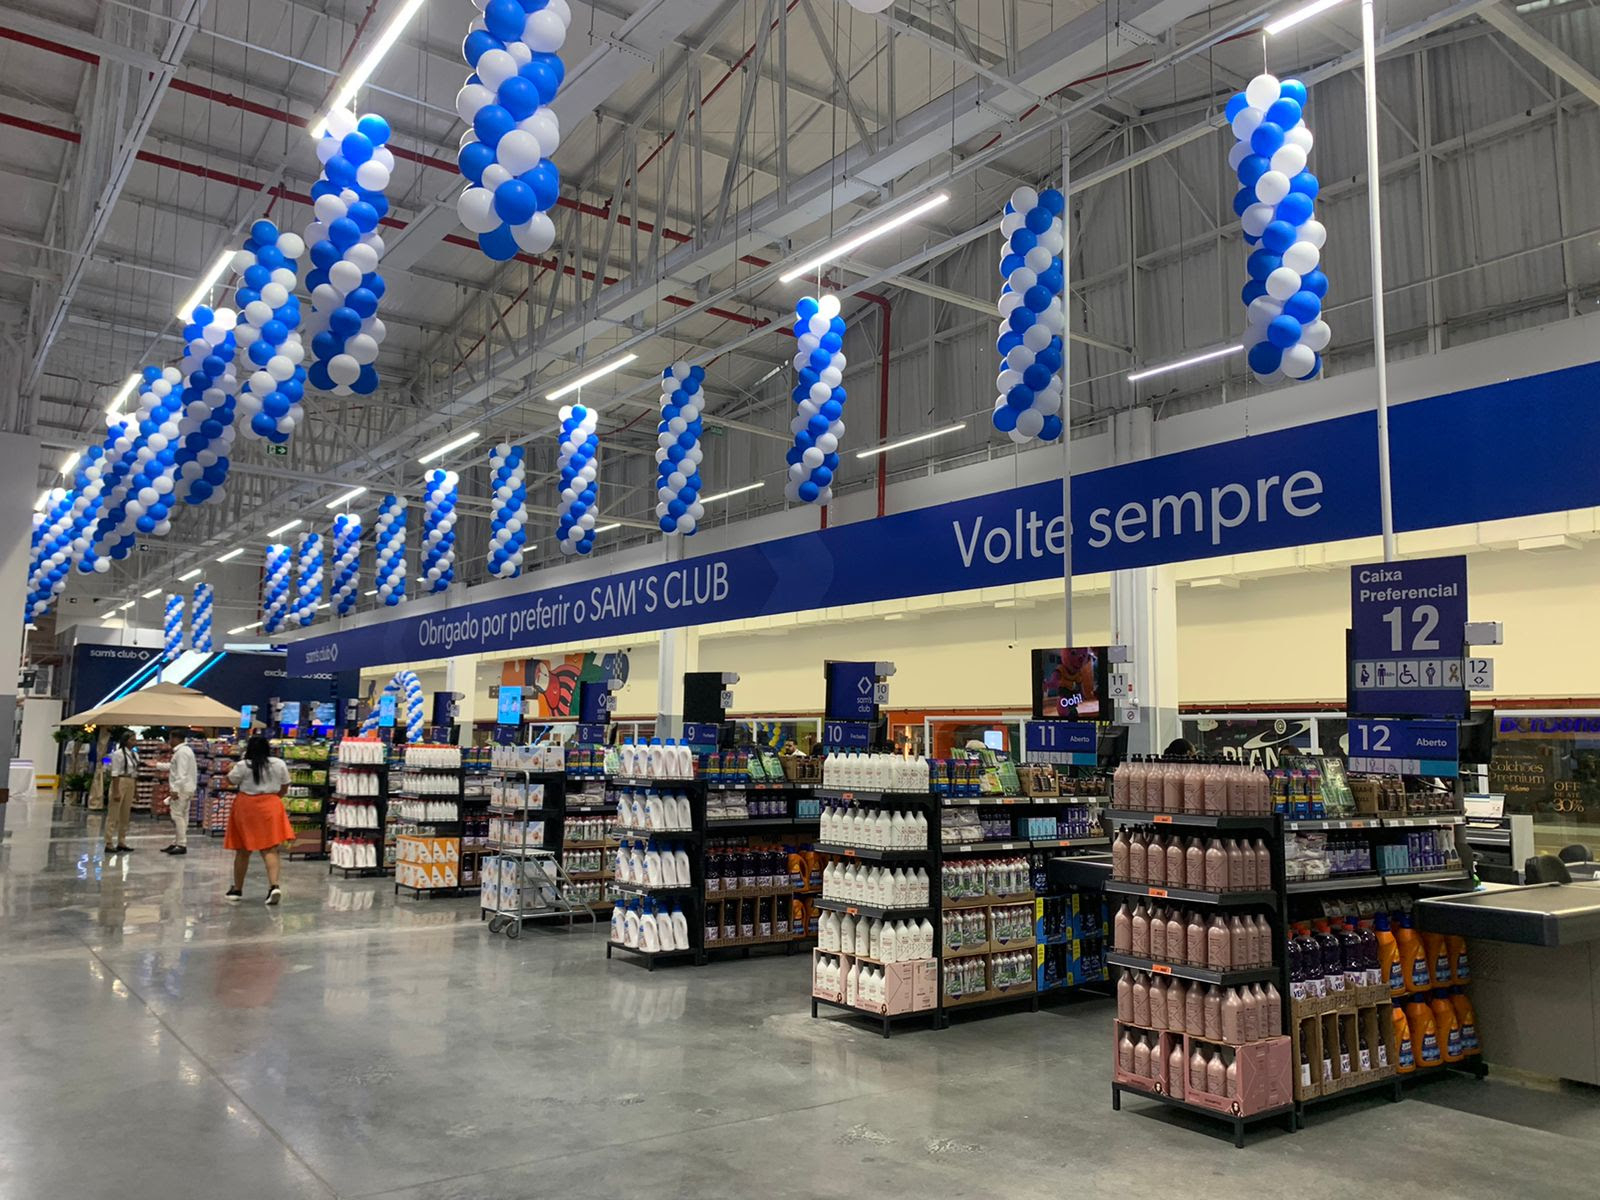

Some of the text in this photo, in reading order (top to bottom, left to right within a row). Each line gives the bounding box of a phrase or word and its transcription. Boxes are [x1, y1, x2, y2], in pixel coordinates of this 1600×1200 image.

[953, 469, 1324, 568] Volte sempre
[1359, 569, 1403, 584] Caixa
[1360, 583, 1458, 602] Preferencial
[418, 561, 729, 650] Obrigado por preferir o SAM'S CLUB
[1382, 604, 1440, 652] 12
[116, 650, 138, 659] club
[1469, 660, 1488, 674] 12
[1111, 675, 1123, 686] 11
[722, 691, 731, 700] 09
[877, 685, 887, 694] 10
[1060, 694, 1083, 707] Ooh!
[582, 727, 588, 740] 8
[688, 726, 696, 741] 9
[828, 725, 843, 743] 10
[1039, 726, 1056, 746] 11
[1070, 735, 1090, 743] Aberto
[1358, 724, 1392, 751] 12
[1416, 737, 1448, 747] Aberto
[1553, 781, 1580, 791] OFF
[1552, 799, 1585, 813] 30%
